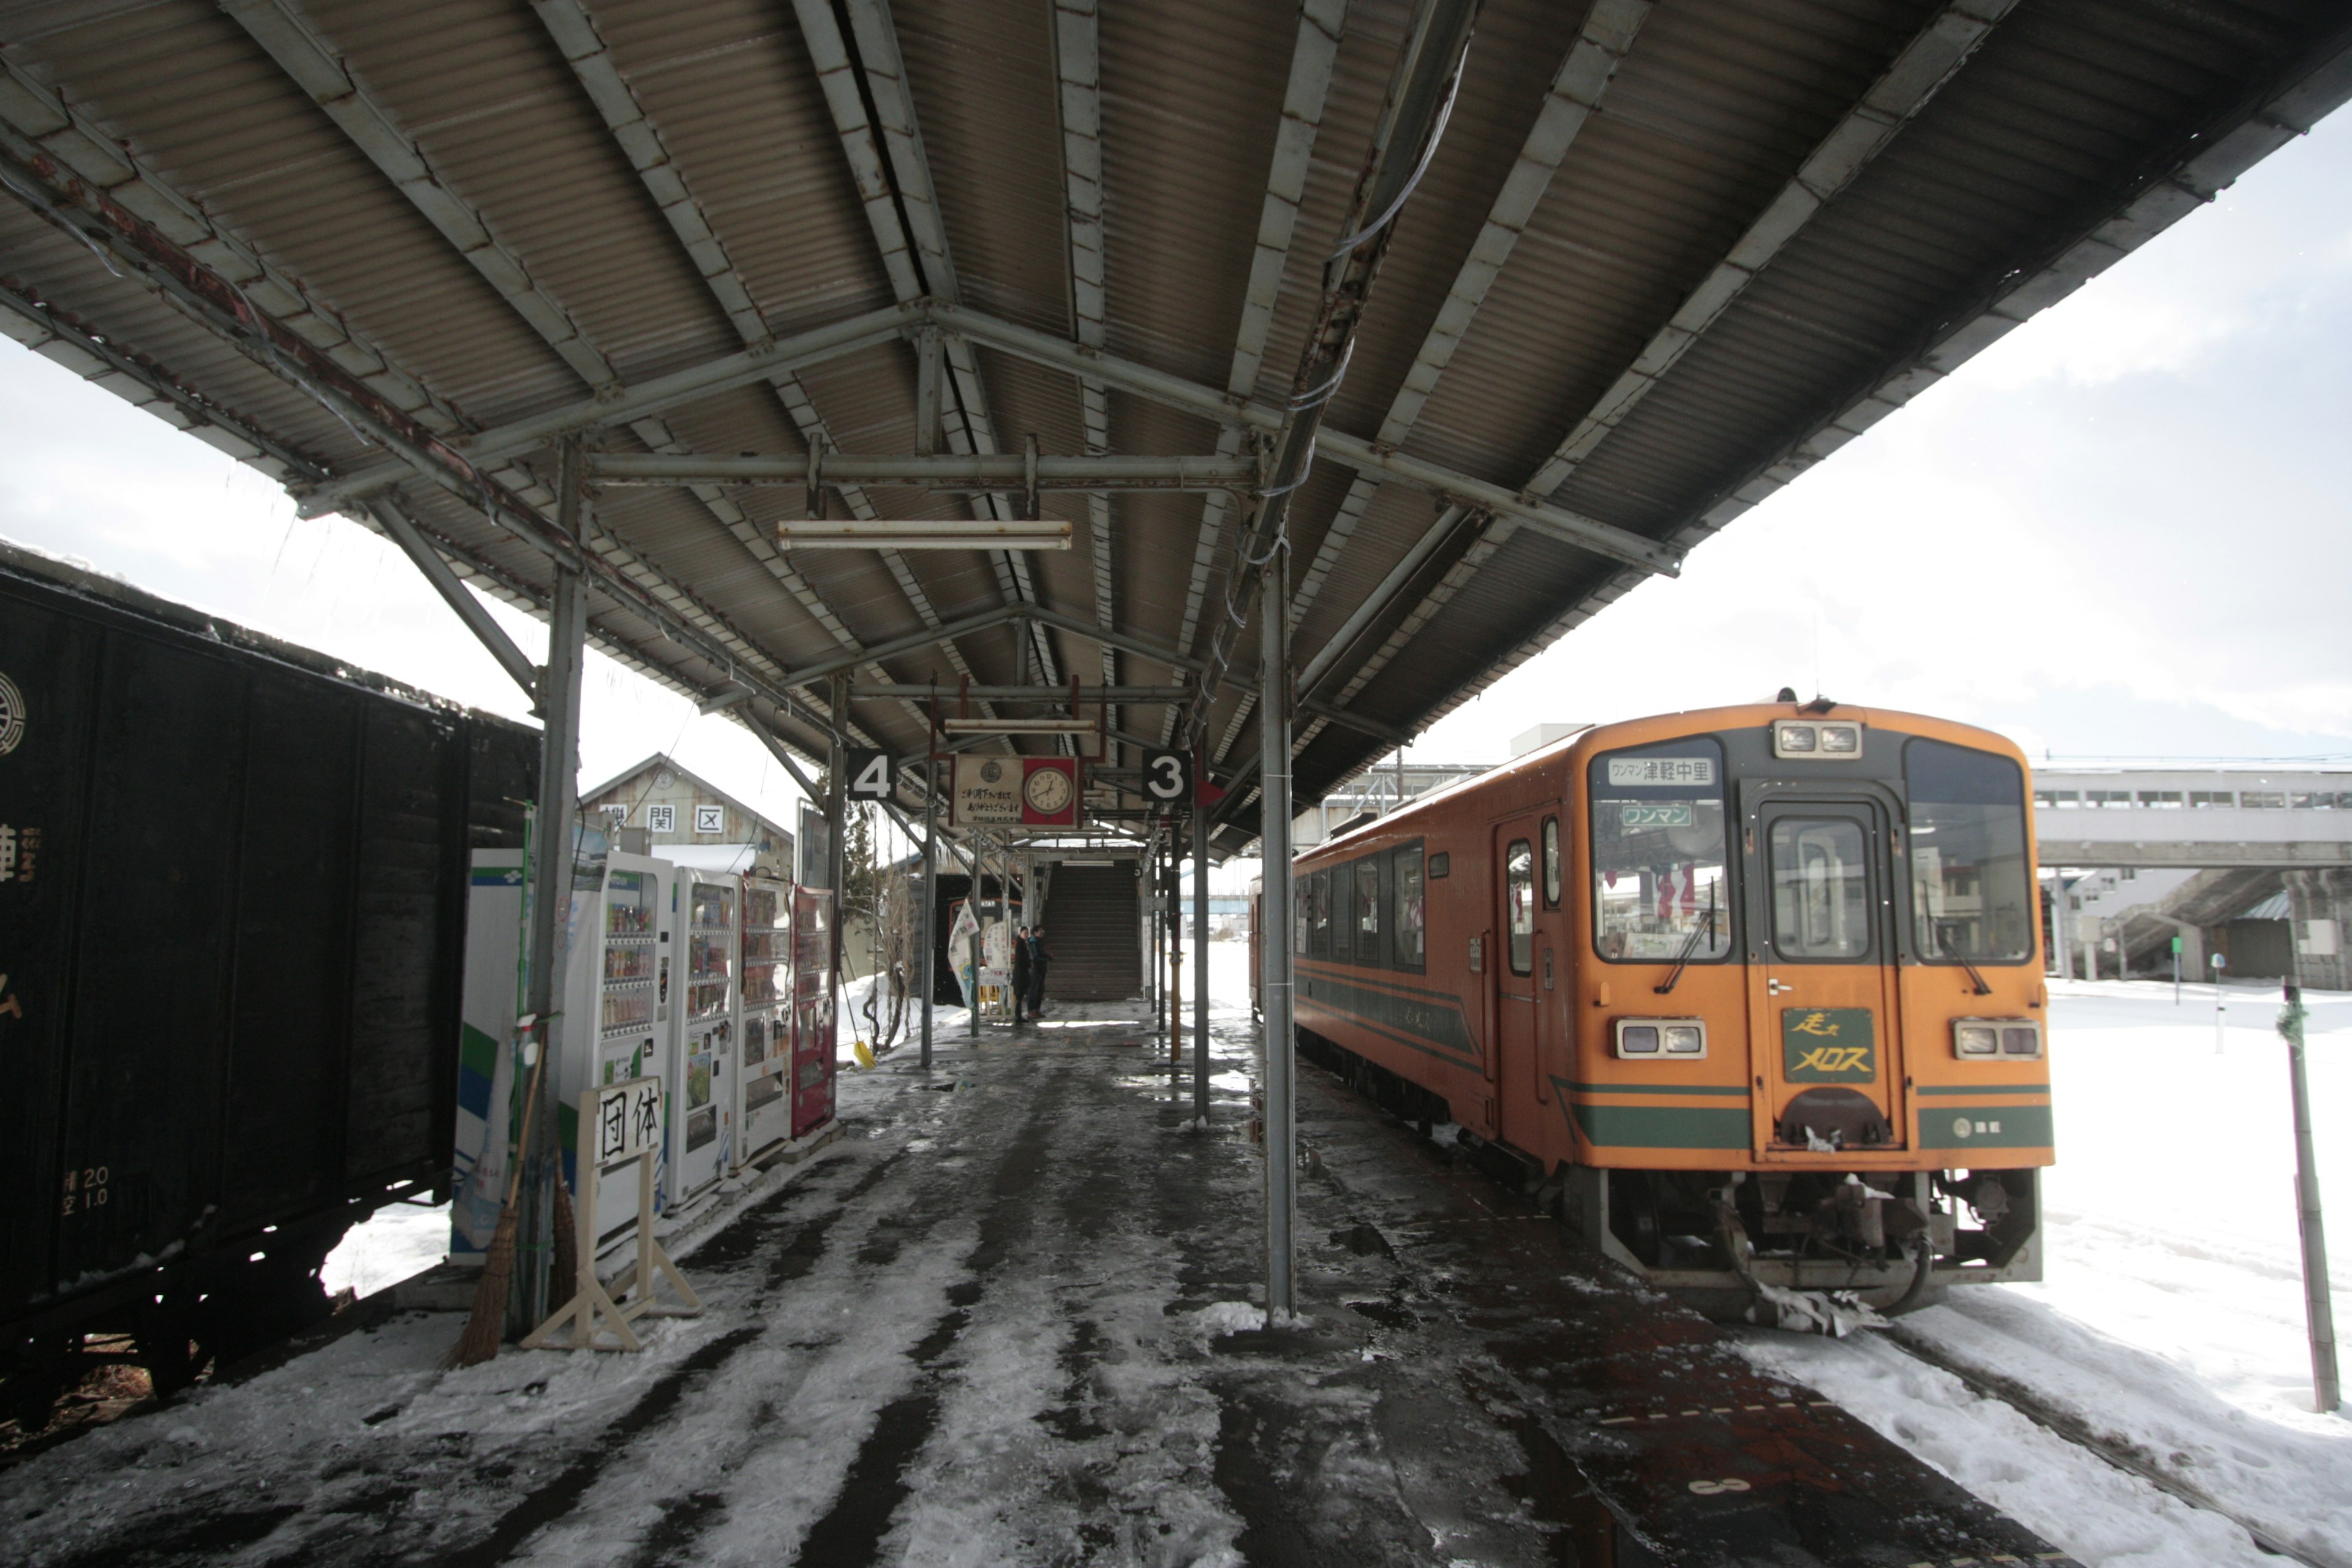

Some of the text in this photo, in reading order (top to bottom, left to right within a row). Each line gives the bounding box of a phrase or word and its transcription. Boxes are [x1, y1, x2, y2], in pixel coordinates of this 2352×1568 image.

[853, 755, 891, 797] 4
[1148, 755, 1183, 798] 3
[1643, 761, 1709, 781] 津軽中里
[1625, 809, 1688, 823] ワンマン
[1791, 1012, 1840, 1036] 走れ
[1792, 1047, 1872, 1072] メロス
[602, 1087, 658, 1159] 団体
[87, 1188, 108, 1210] 1.0
